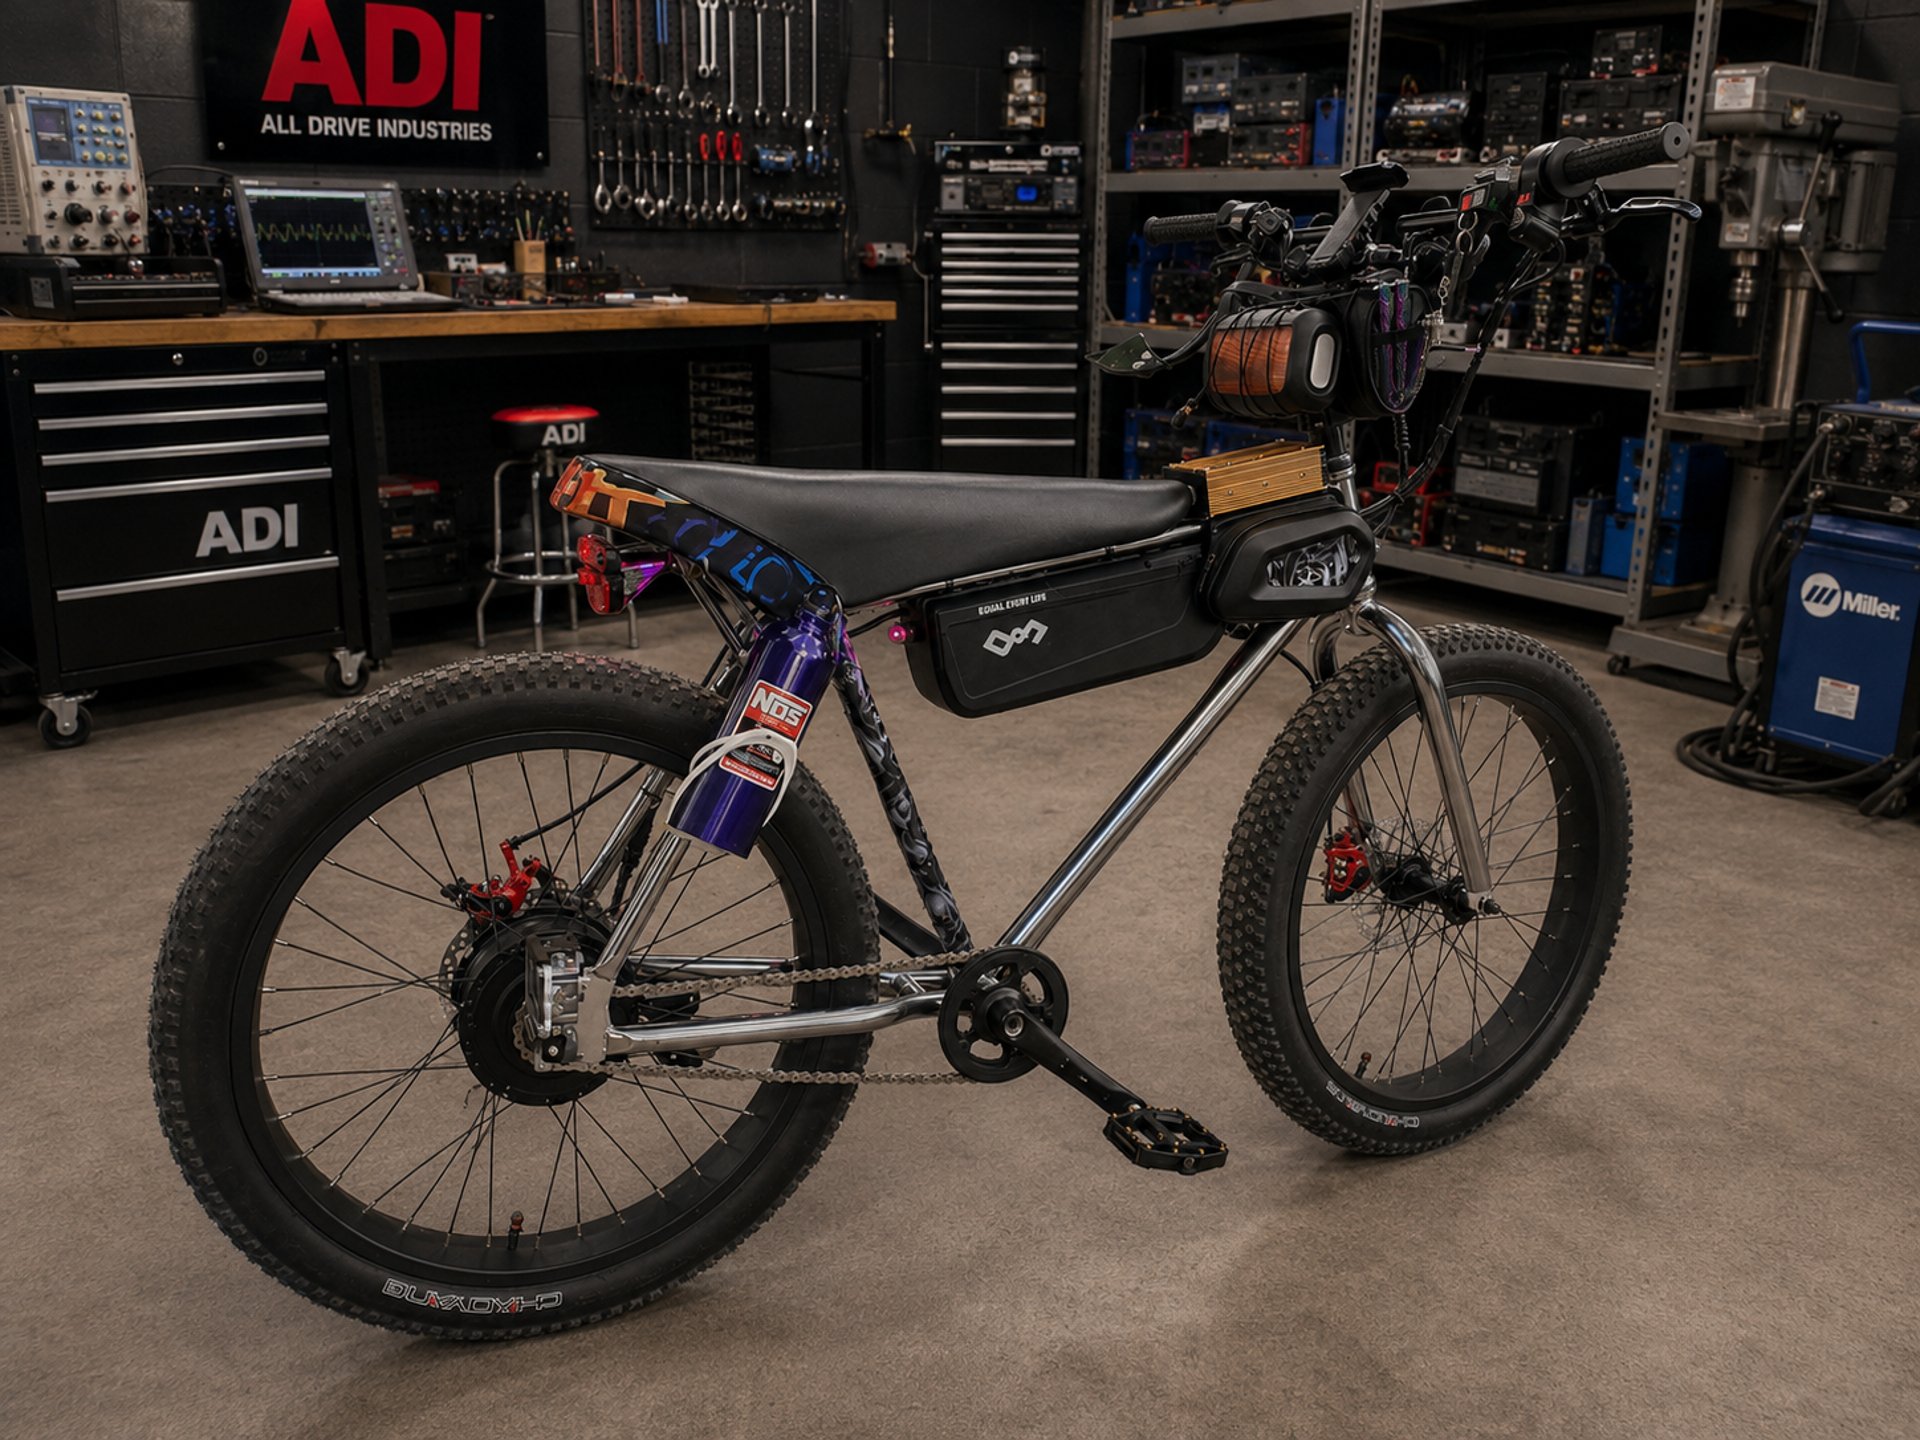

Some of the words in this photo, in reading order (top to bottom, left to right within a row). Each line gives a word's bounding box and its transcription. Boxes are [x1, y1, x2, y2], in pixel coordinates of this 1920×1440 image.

[261, 0, 482, 111] ADI
[261, 114, 302, 134] ALL
[308, 116, 371, 137] DRIVE
[378, 118, 493, 141] INDUSTRIES
[541, 421, 586, 446] ADI
[196, 503, 299, 558] ADI
[750, 687, 808, 726] NOS
[382, 1278, 563, 1314] CHAOYANG
